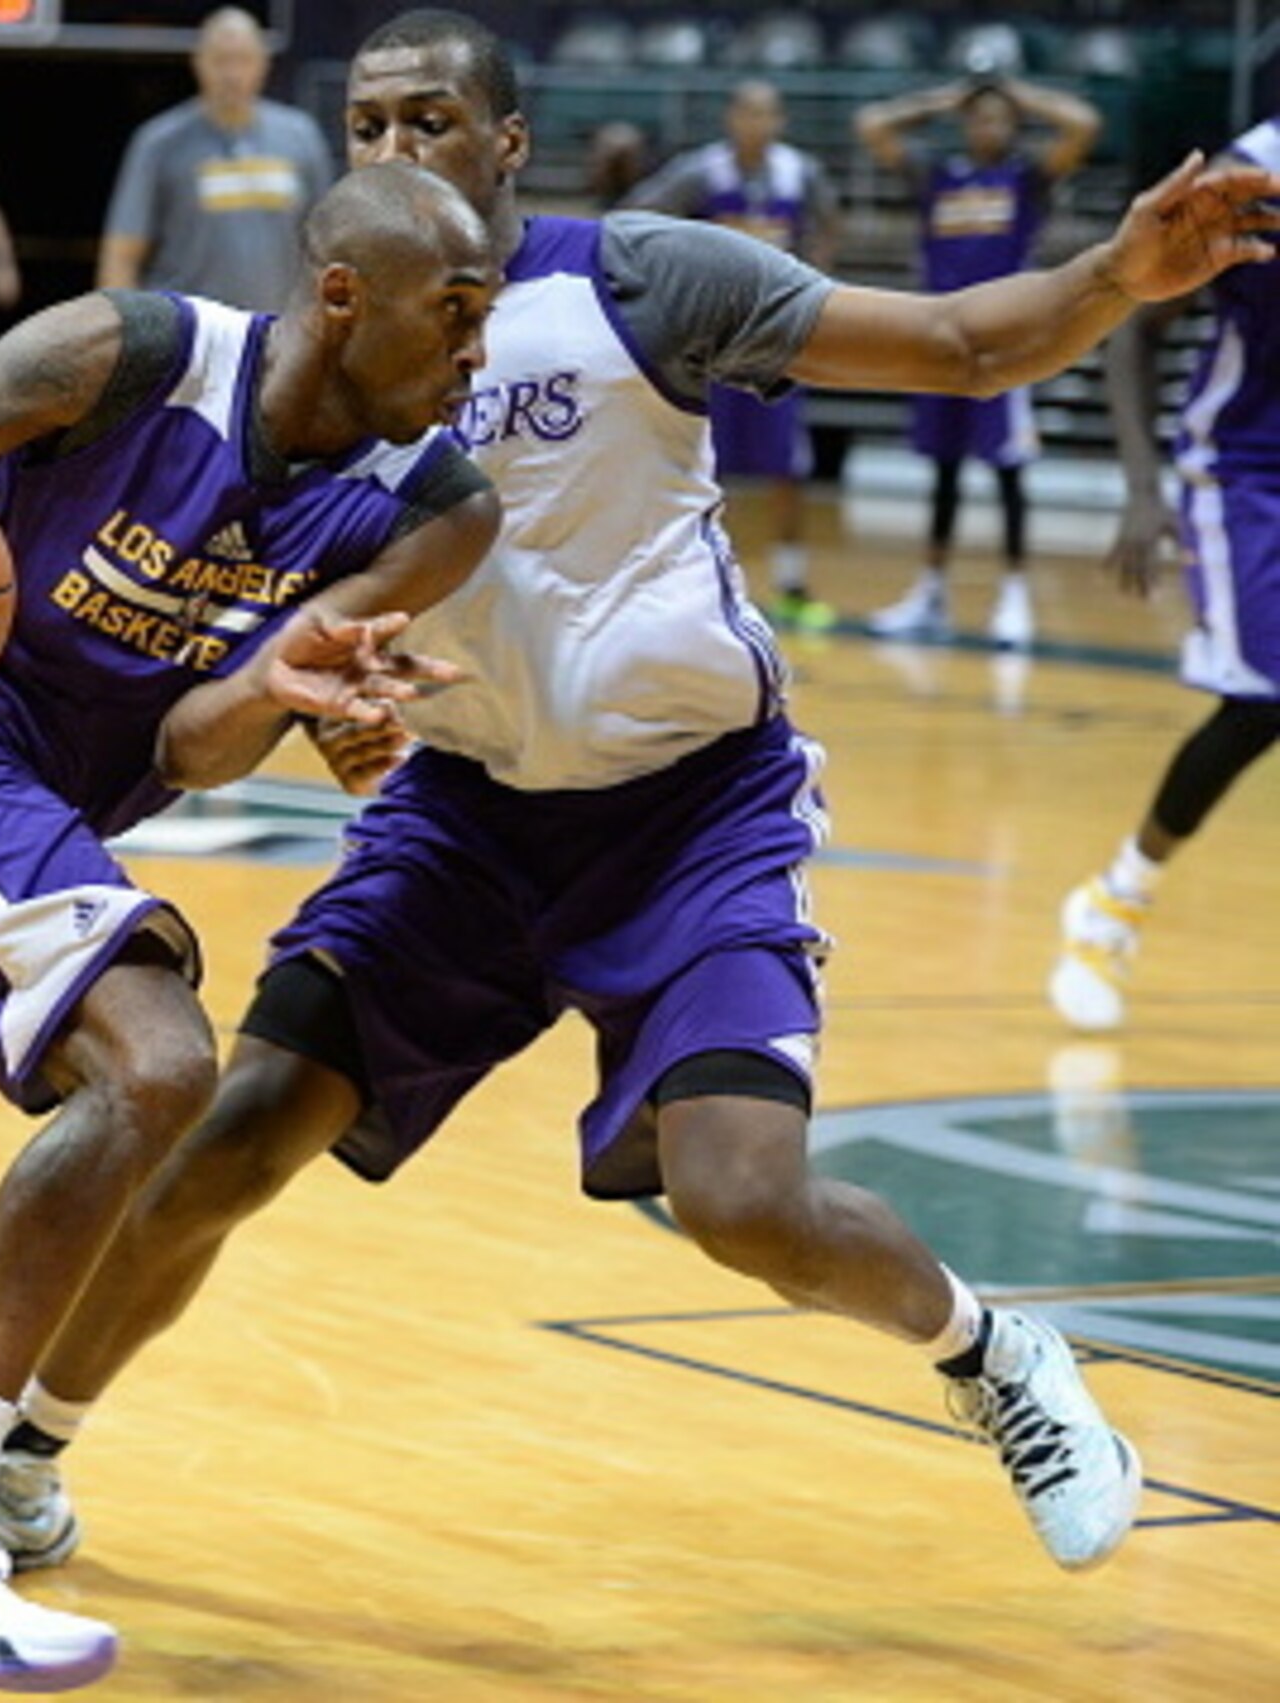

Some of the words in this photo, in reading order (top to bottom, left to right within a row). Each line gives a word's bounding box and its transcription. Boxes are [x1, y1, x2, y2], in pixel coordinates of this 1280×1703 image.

[453, 371, 583, 450] ERS
[97, 509, 174, 580] LOS
[169, 557, 319, 605] ANGELE
